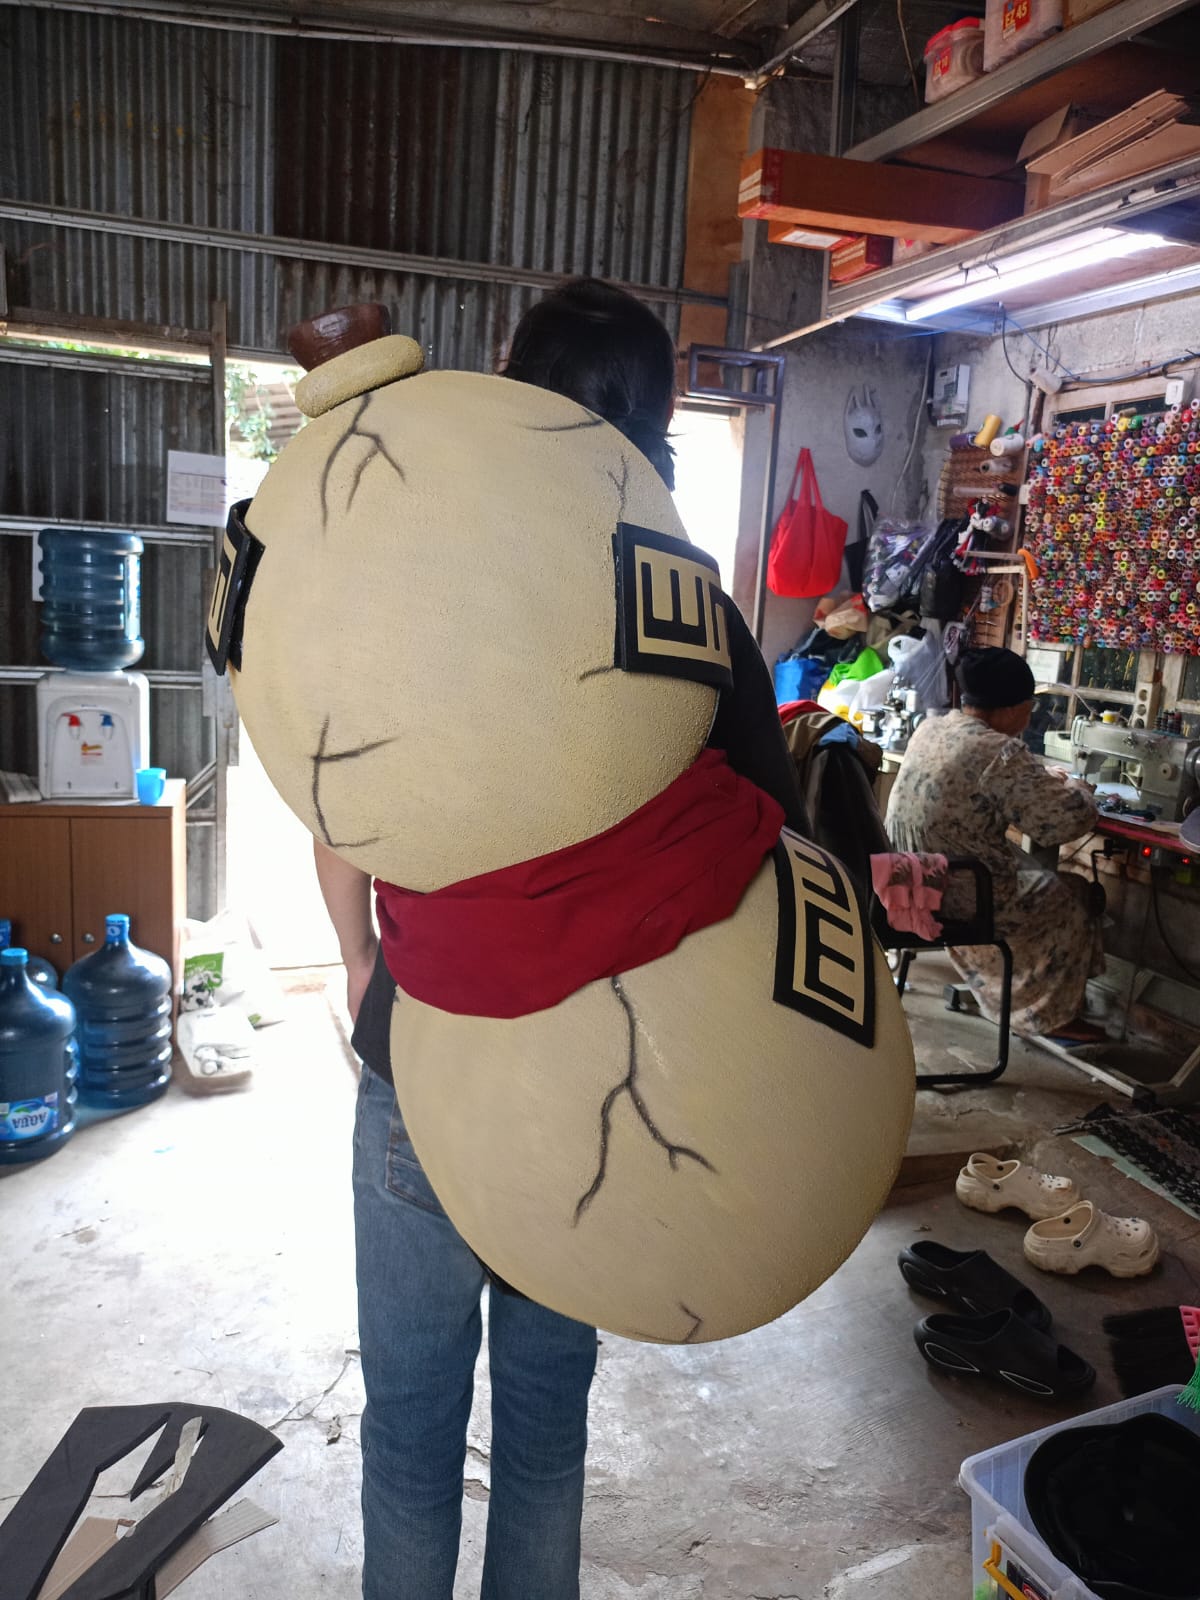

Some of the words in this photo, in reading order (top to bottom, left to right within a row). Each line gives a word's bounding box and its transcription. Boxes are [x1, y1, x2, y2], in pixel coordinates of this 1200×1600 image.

[1004, 9, 1016, 28] EZ
[1016, 1, 1028, 19] 45
[11, 1111, 47, 1129] AQUA
